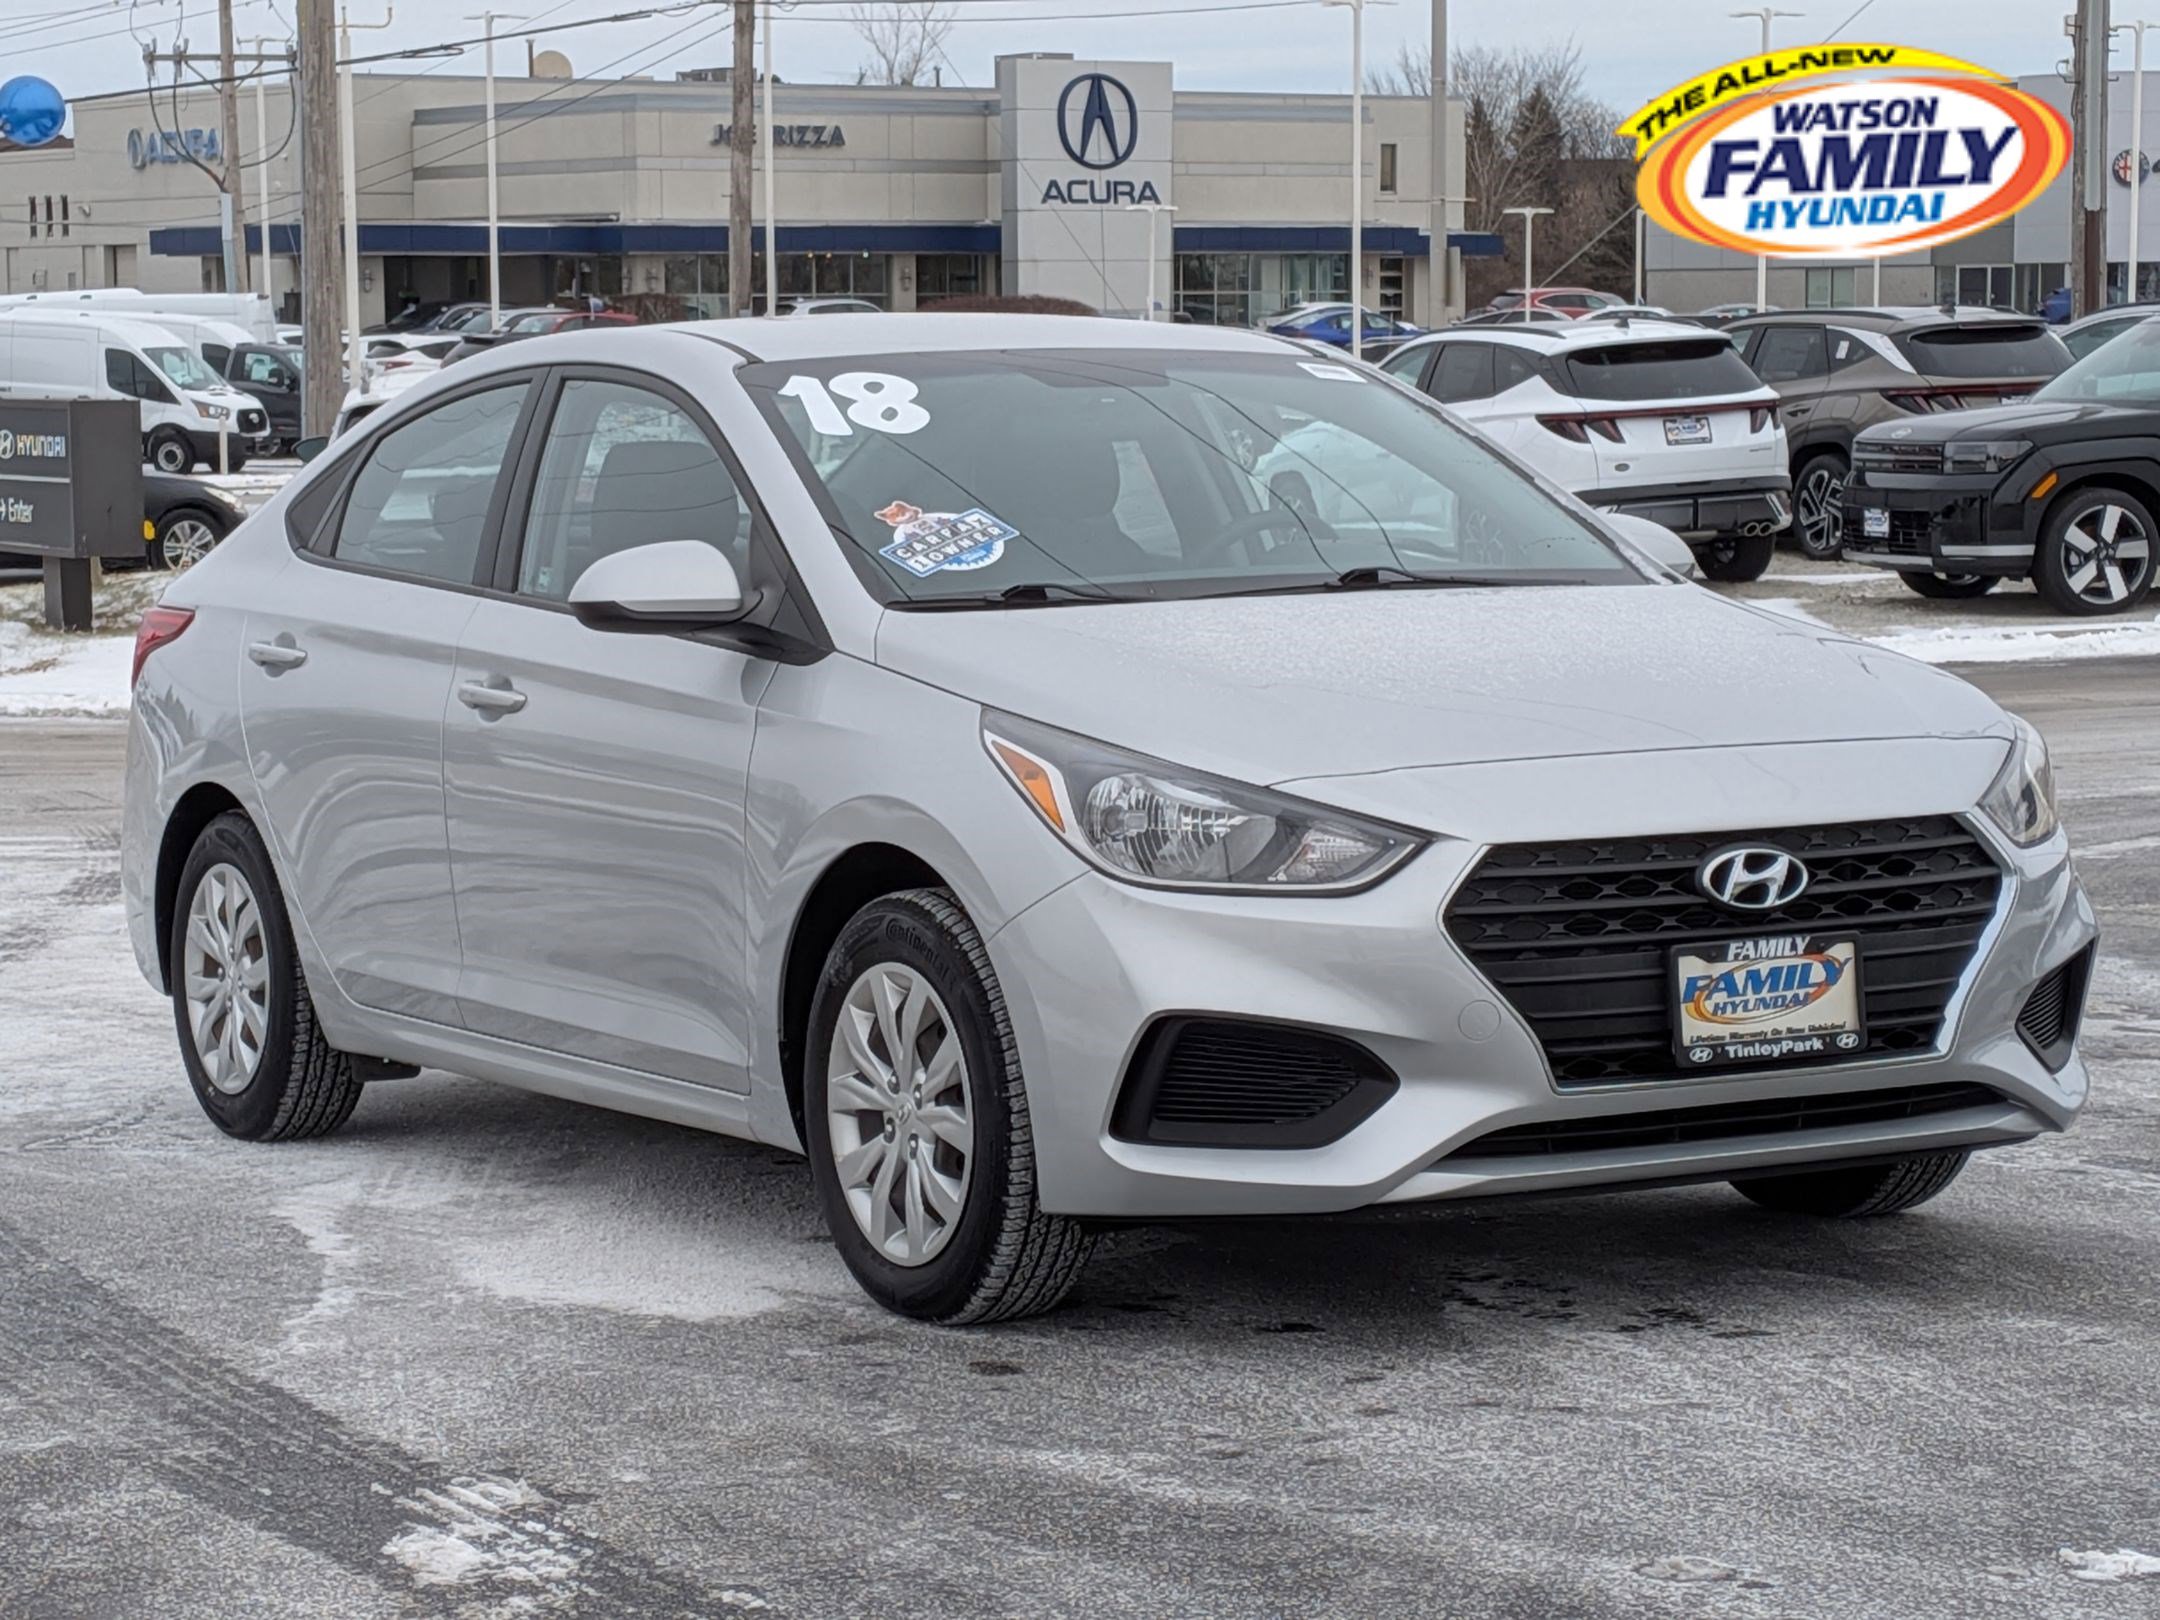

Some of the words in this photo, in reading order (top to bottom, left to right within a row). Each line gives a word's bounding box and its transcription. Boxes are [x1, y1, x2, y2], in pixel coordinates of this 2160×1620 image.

[772, 124, 846, 147] RIZZA
[1041, 179, 1162, 205] ACURA
[777, 371, 931, 436] 18
[16, 434, 66, 458] HYUNDAI
[1727, 936, 1811, 962] FAMILY
[1682, 957, 1853, 1004] FAMILY
[1712, 991, 1811, 1017] HYUNDAI
